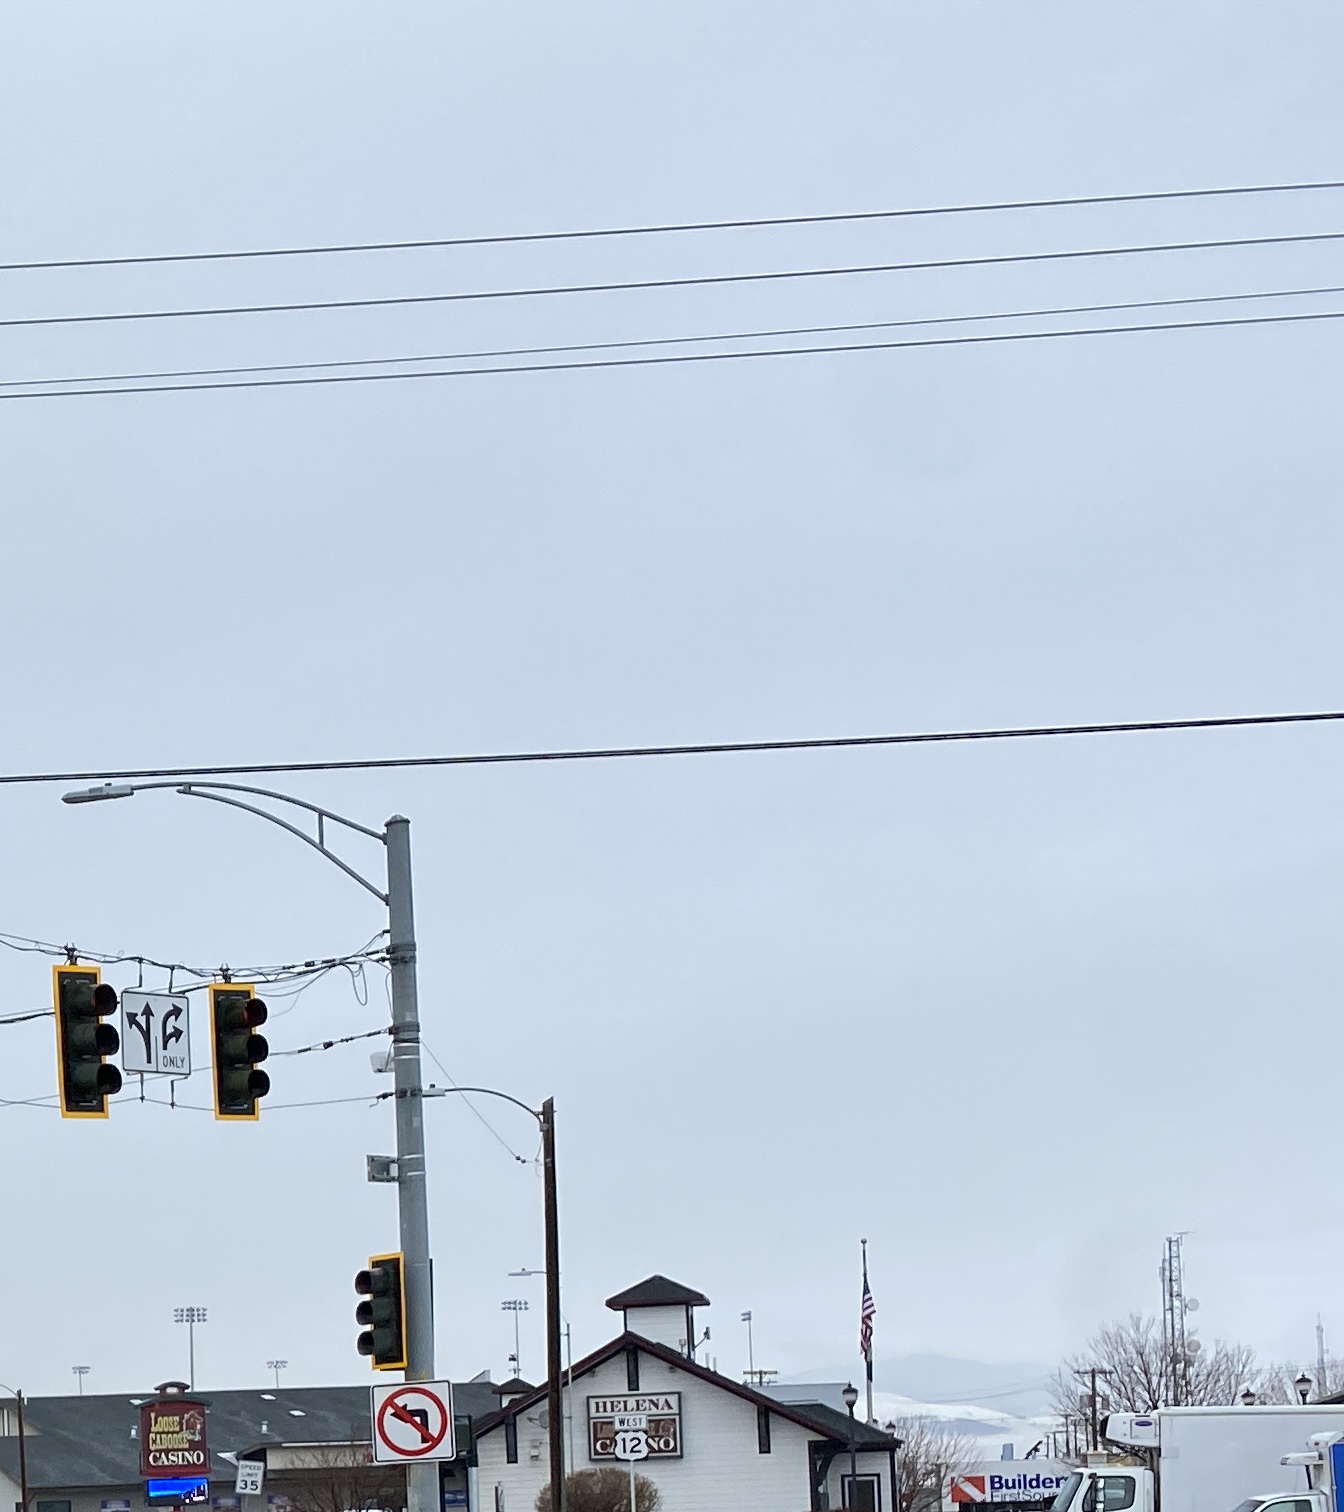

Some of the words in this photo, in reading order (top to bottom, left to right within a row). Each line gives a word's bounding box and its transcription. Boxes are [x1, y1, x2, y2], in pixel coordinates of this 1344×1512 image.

[162, 1055, 186, 1069] ONLY
[594, 1398, 674, 1414] HELENA
[151, 1412, 179, 1432] LOOSE
[618, 1417, 643, 1427] WEST
[148, 1432, 190, 1451] CABOOSE
[620, 1436, 643, 1454] 12
[149, 1451, 204, 1466] CASINO
[238, 1479, 260, 1492] 35
[989, 1473, 1069, 1490] Builder
